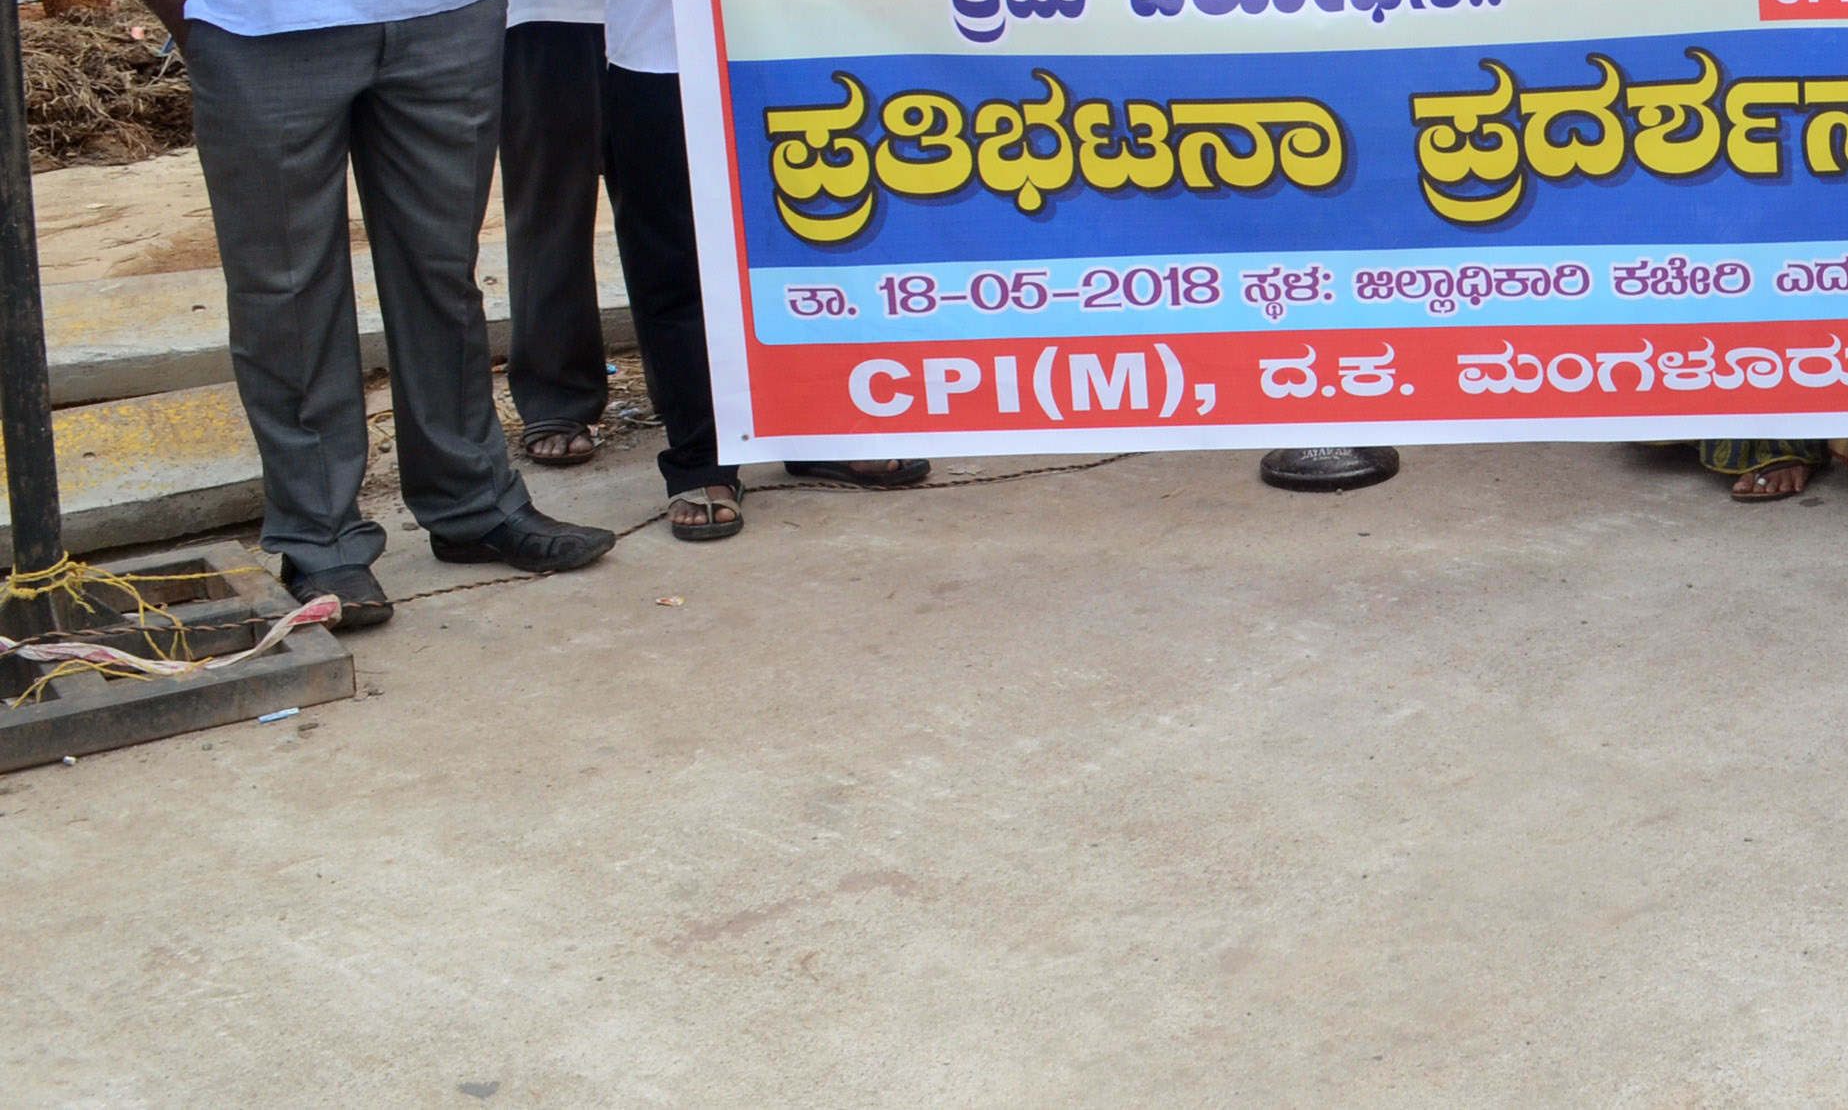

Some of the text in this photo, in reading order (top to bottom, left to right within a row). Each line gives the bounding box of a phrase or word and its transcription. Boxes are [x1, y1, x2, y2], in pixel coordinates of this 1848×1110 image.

[764, 67, 1348, 246] ಪ್ರತಿಭಟನಾ
[787, 287, 858, 317] ತಾ.
[878, 265, 1221, 317] 18-05-2018
[1243, 266, 1333, 320] ಸ್ಥಳ:
[1355, 264, 1591, 314] ಜಿಲ್ಲಾಧಿಕಾರಿ
[1613, 257, 1751, 296] ಕಚೇರಿ
[848, 342, 1218, 421] CPI(M),
[1258, 341, 1415, 399] ದ.ಕ.
